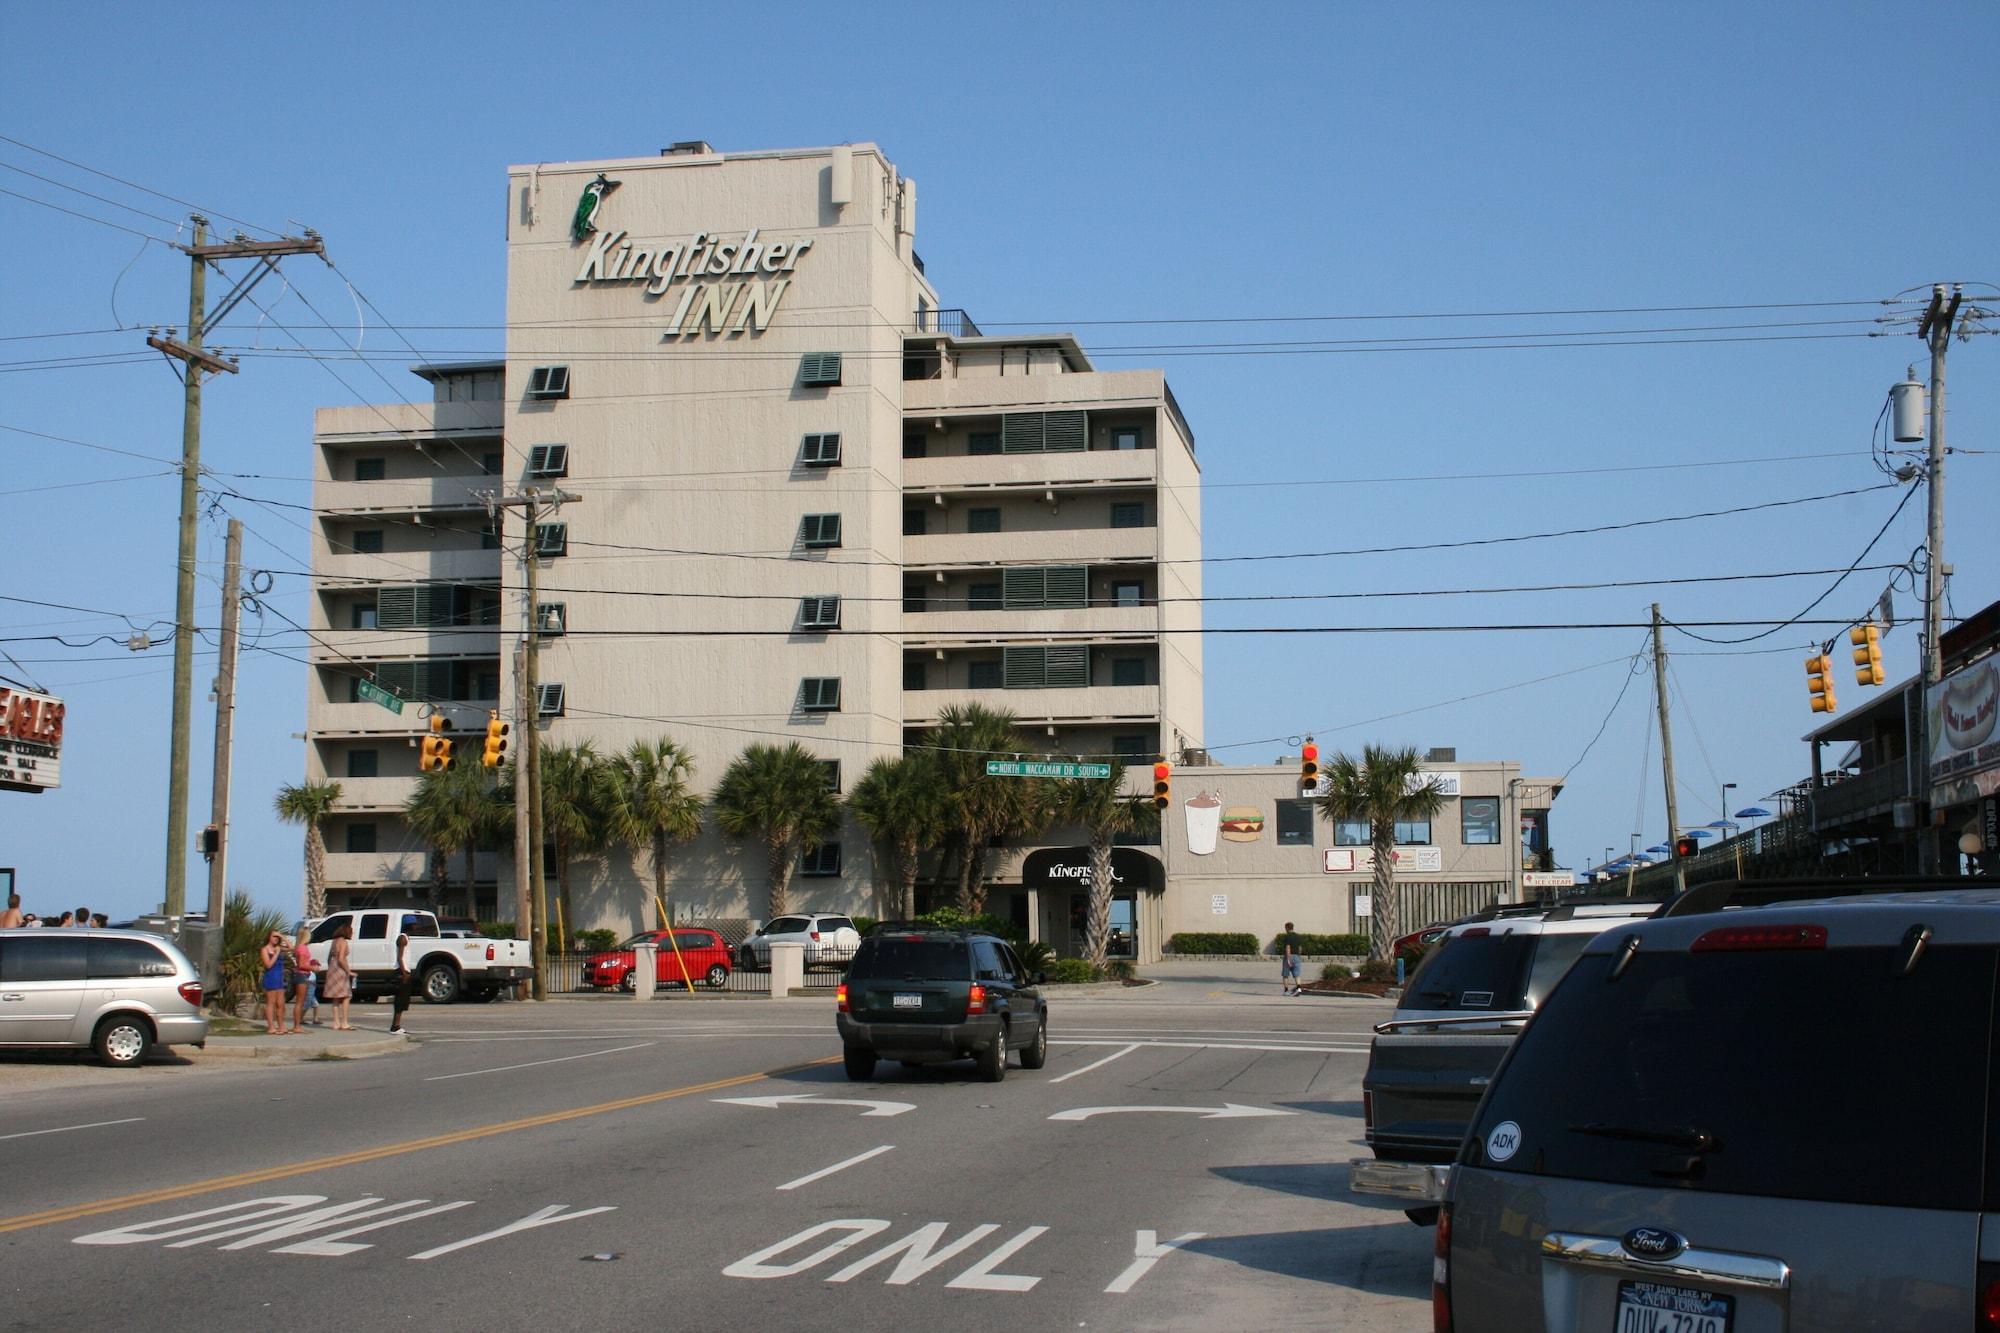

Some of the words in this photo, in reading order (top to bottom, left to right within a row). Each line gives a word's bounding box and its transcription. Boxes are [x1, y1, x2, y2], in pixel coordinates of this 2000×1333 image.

[574, 229, 814, 295] Kingfisher
[664, 279, 791, 335] INN
[17, 757, 37, 769] SALE
[1000, 763, 1020, 774] NORTH
[1025, 764, 1061, 776] WACCAMAW
[1064, 765, 1074, 776] DR
[1078, 766, 1099, 777] SOUTH
[1048, 863, 1124, 881] KINGFISR
[1491, 1133, 1516, 1149] ADK
[71, 1194, 618, 1259] ONLY
[1631, 1229, 1668, 1252] Ford
[722, 1218, 1208, 1293] ONLY
[1634, 1281, 1655, 1293] WEST
[1656, 1284, 1677, 1296] SAND
[1645, 1292, 1668, 1307] NEW
[1674, 1295, 1702, 1313] YORK
